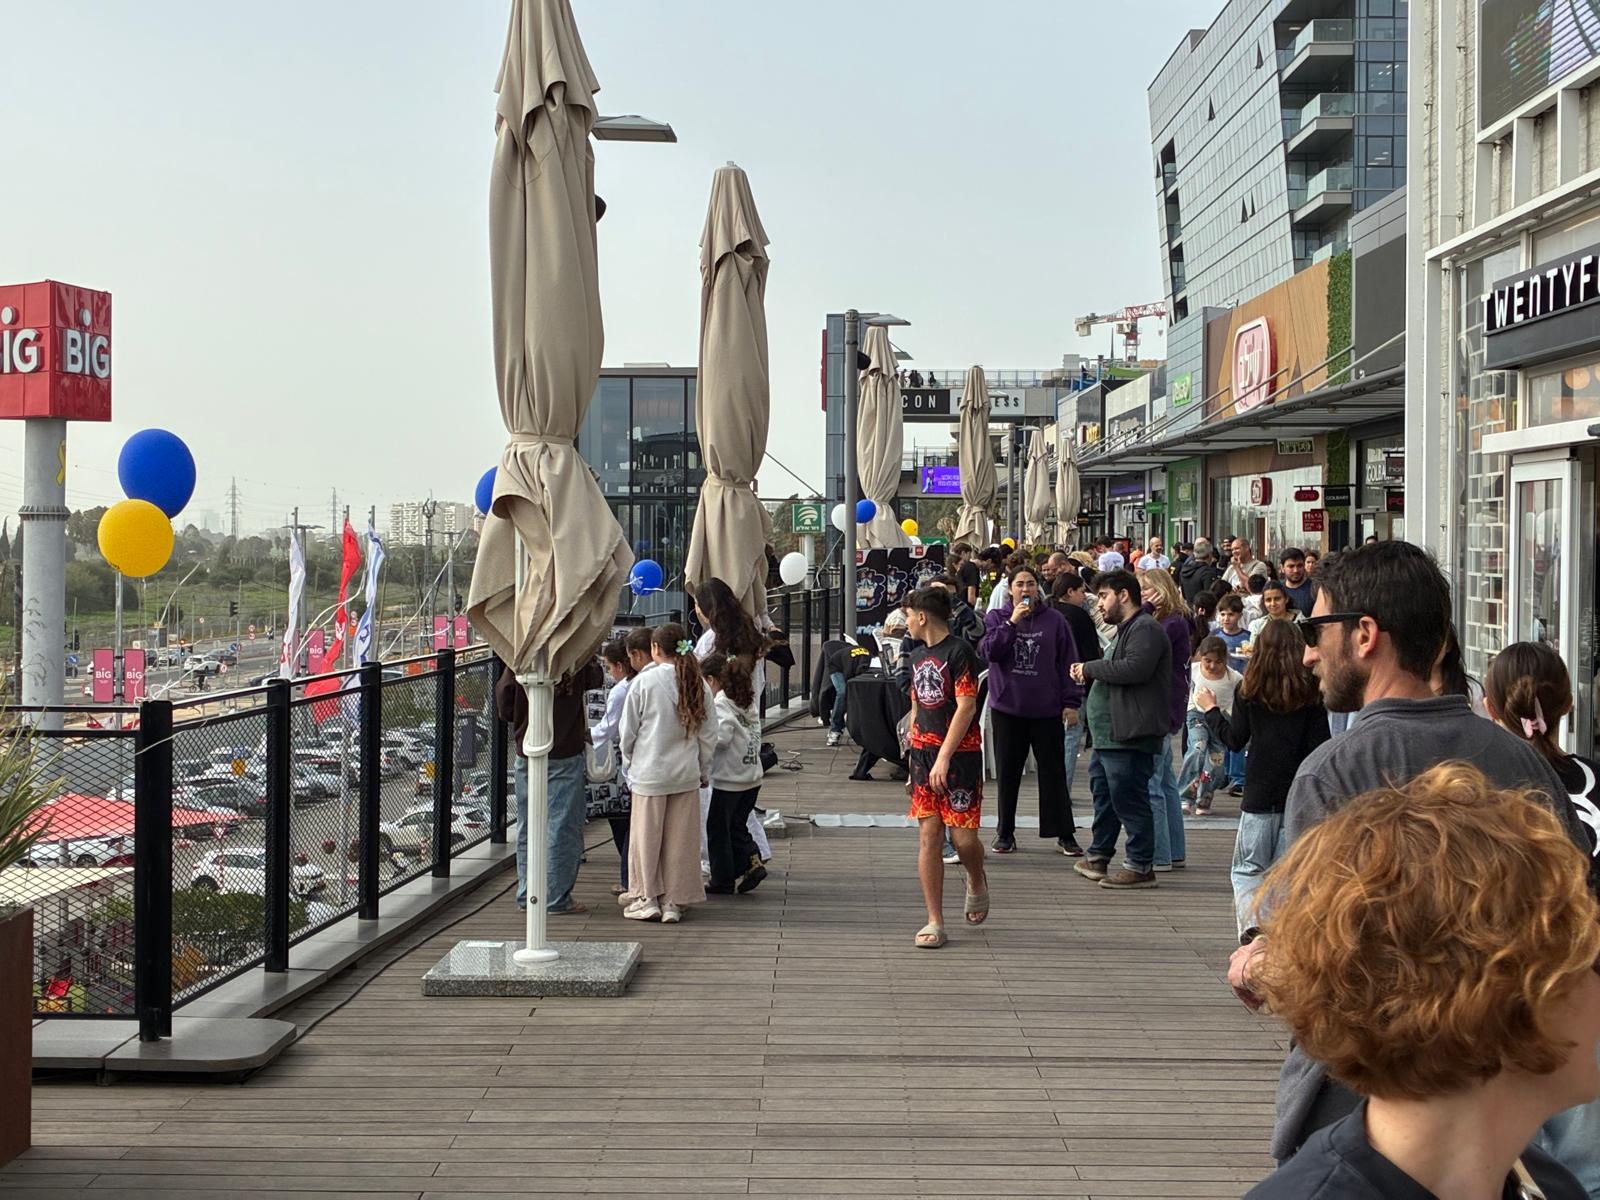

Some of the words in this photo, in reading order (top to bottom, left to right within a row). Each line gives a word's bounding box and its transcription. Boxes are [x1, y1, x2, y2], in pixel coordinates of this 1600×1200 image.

[1481, 254, 1600, 333] TWENTYF
[0, 328, 41, 373] IG
[64, 328, 110, 379] BIG
[957, 396, 1020, 408] FESS
[309, 645, 323, 654] BIG
[95, 668, 112, 679] BIG
[126, 668, 143, 679] BIG
